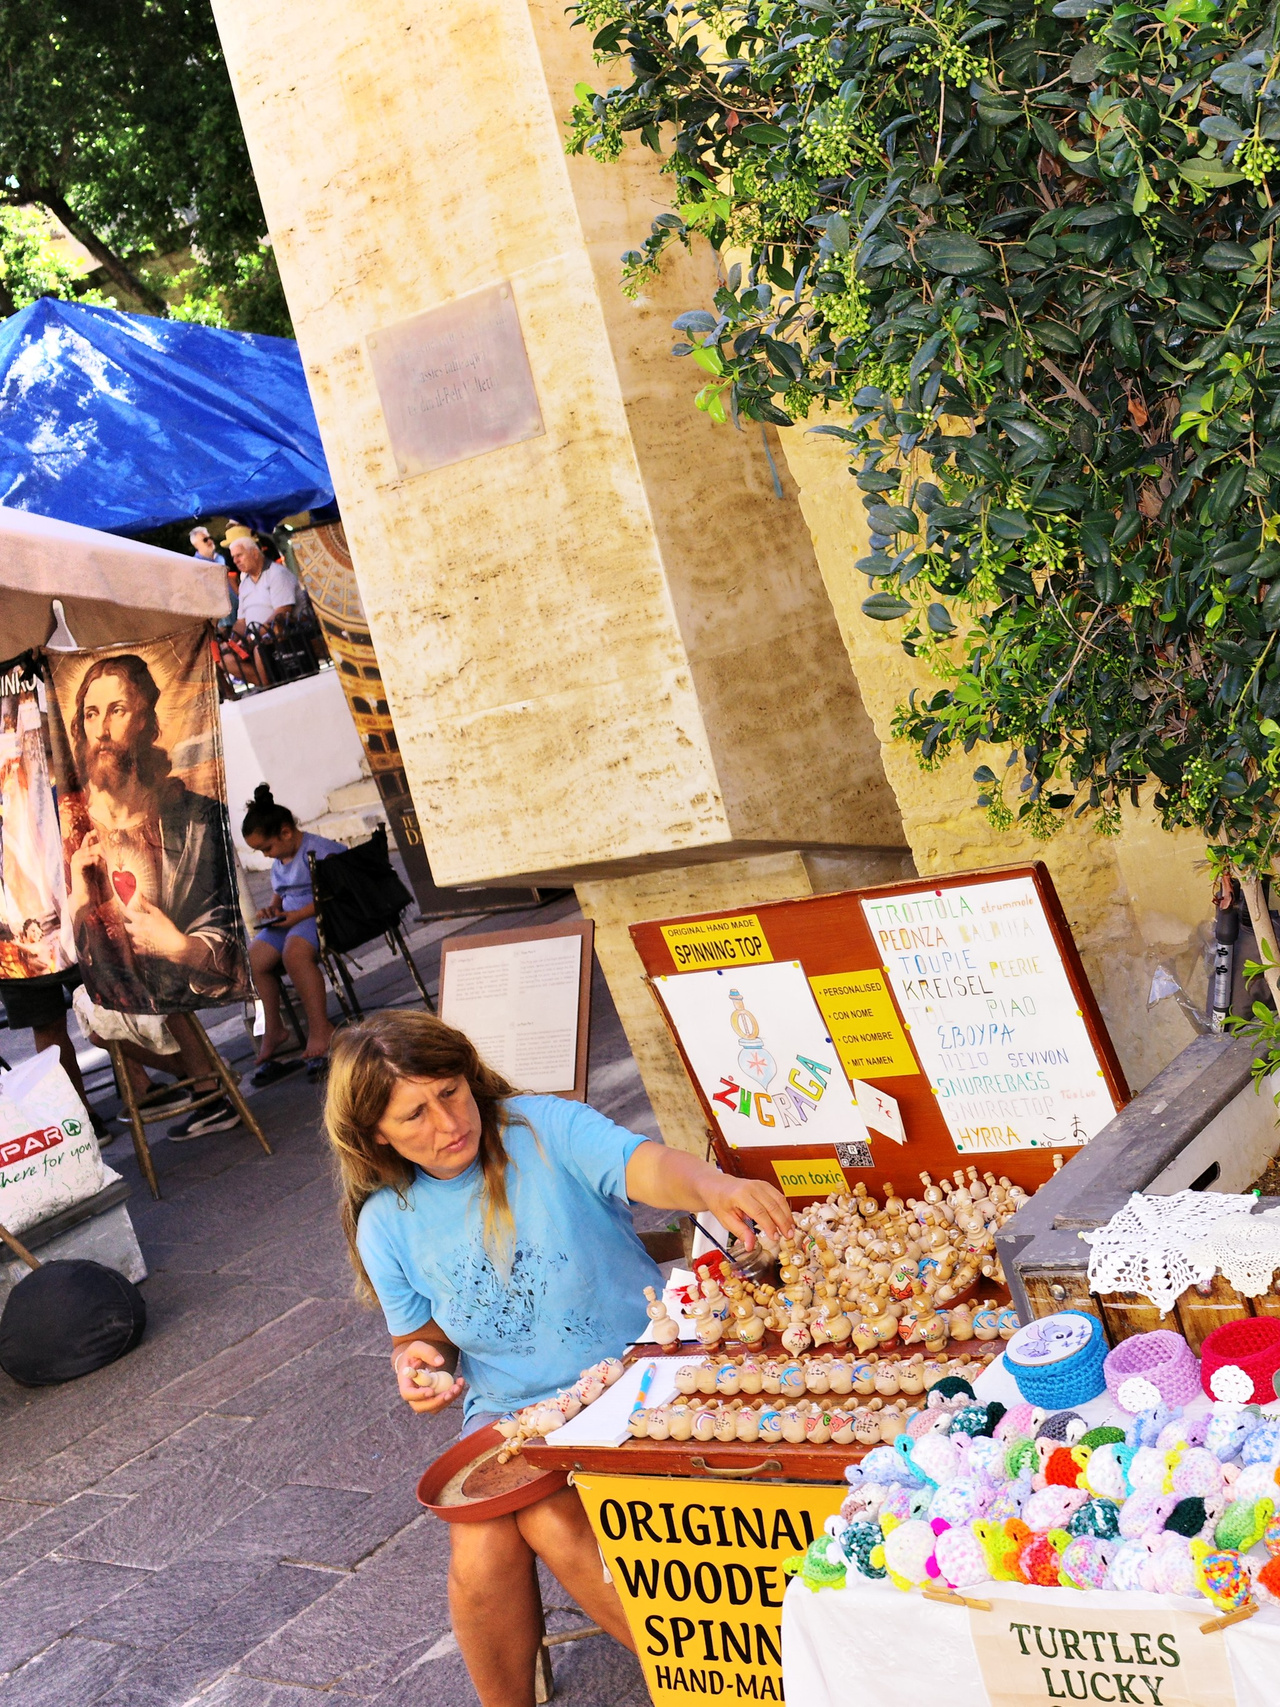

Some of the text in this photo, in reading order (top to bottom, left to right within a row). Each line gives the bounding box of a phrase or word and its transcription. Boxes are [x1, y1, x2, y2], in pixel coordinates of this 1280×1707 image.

[870, 895, 974, 925] TROTTOLA
[667, 919, 755, 937] ORIGINAL HAND MADE
[878, 926, 948, 952] PEONZA
[674, 936, 762, 965] SPINNING TOP
[898, 949, 1044, 979] TOUPIE PEERIE
[823, 982, 882, 997] PERSONALISED
[902, 974, 994, 1003] KREISEL
[832, 1008, 874, 1021] CON NOME
[842, 1031, 894, 1044] CON NOMBRE
[851, 1056, 894, 1067] MIT NAMEN
[1007, 1047, 1070, 1068] SEVIVON
[936, 1071, 1050, 1098] SNURREBASS
[946, 1095, 1054, 1123] SNURRETOP
[42, 1152, 65, 1177] for
[781, 1170, 844, 1186] non toxic
[615, 1556, 794, 1607] WOODE
[1010, 1622, 1181, 1667] TURTLES
[1042, 1667, 1164, 1706] LUCKY
